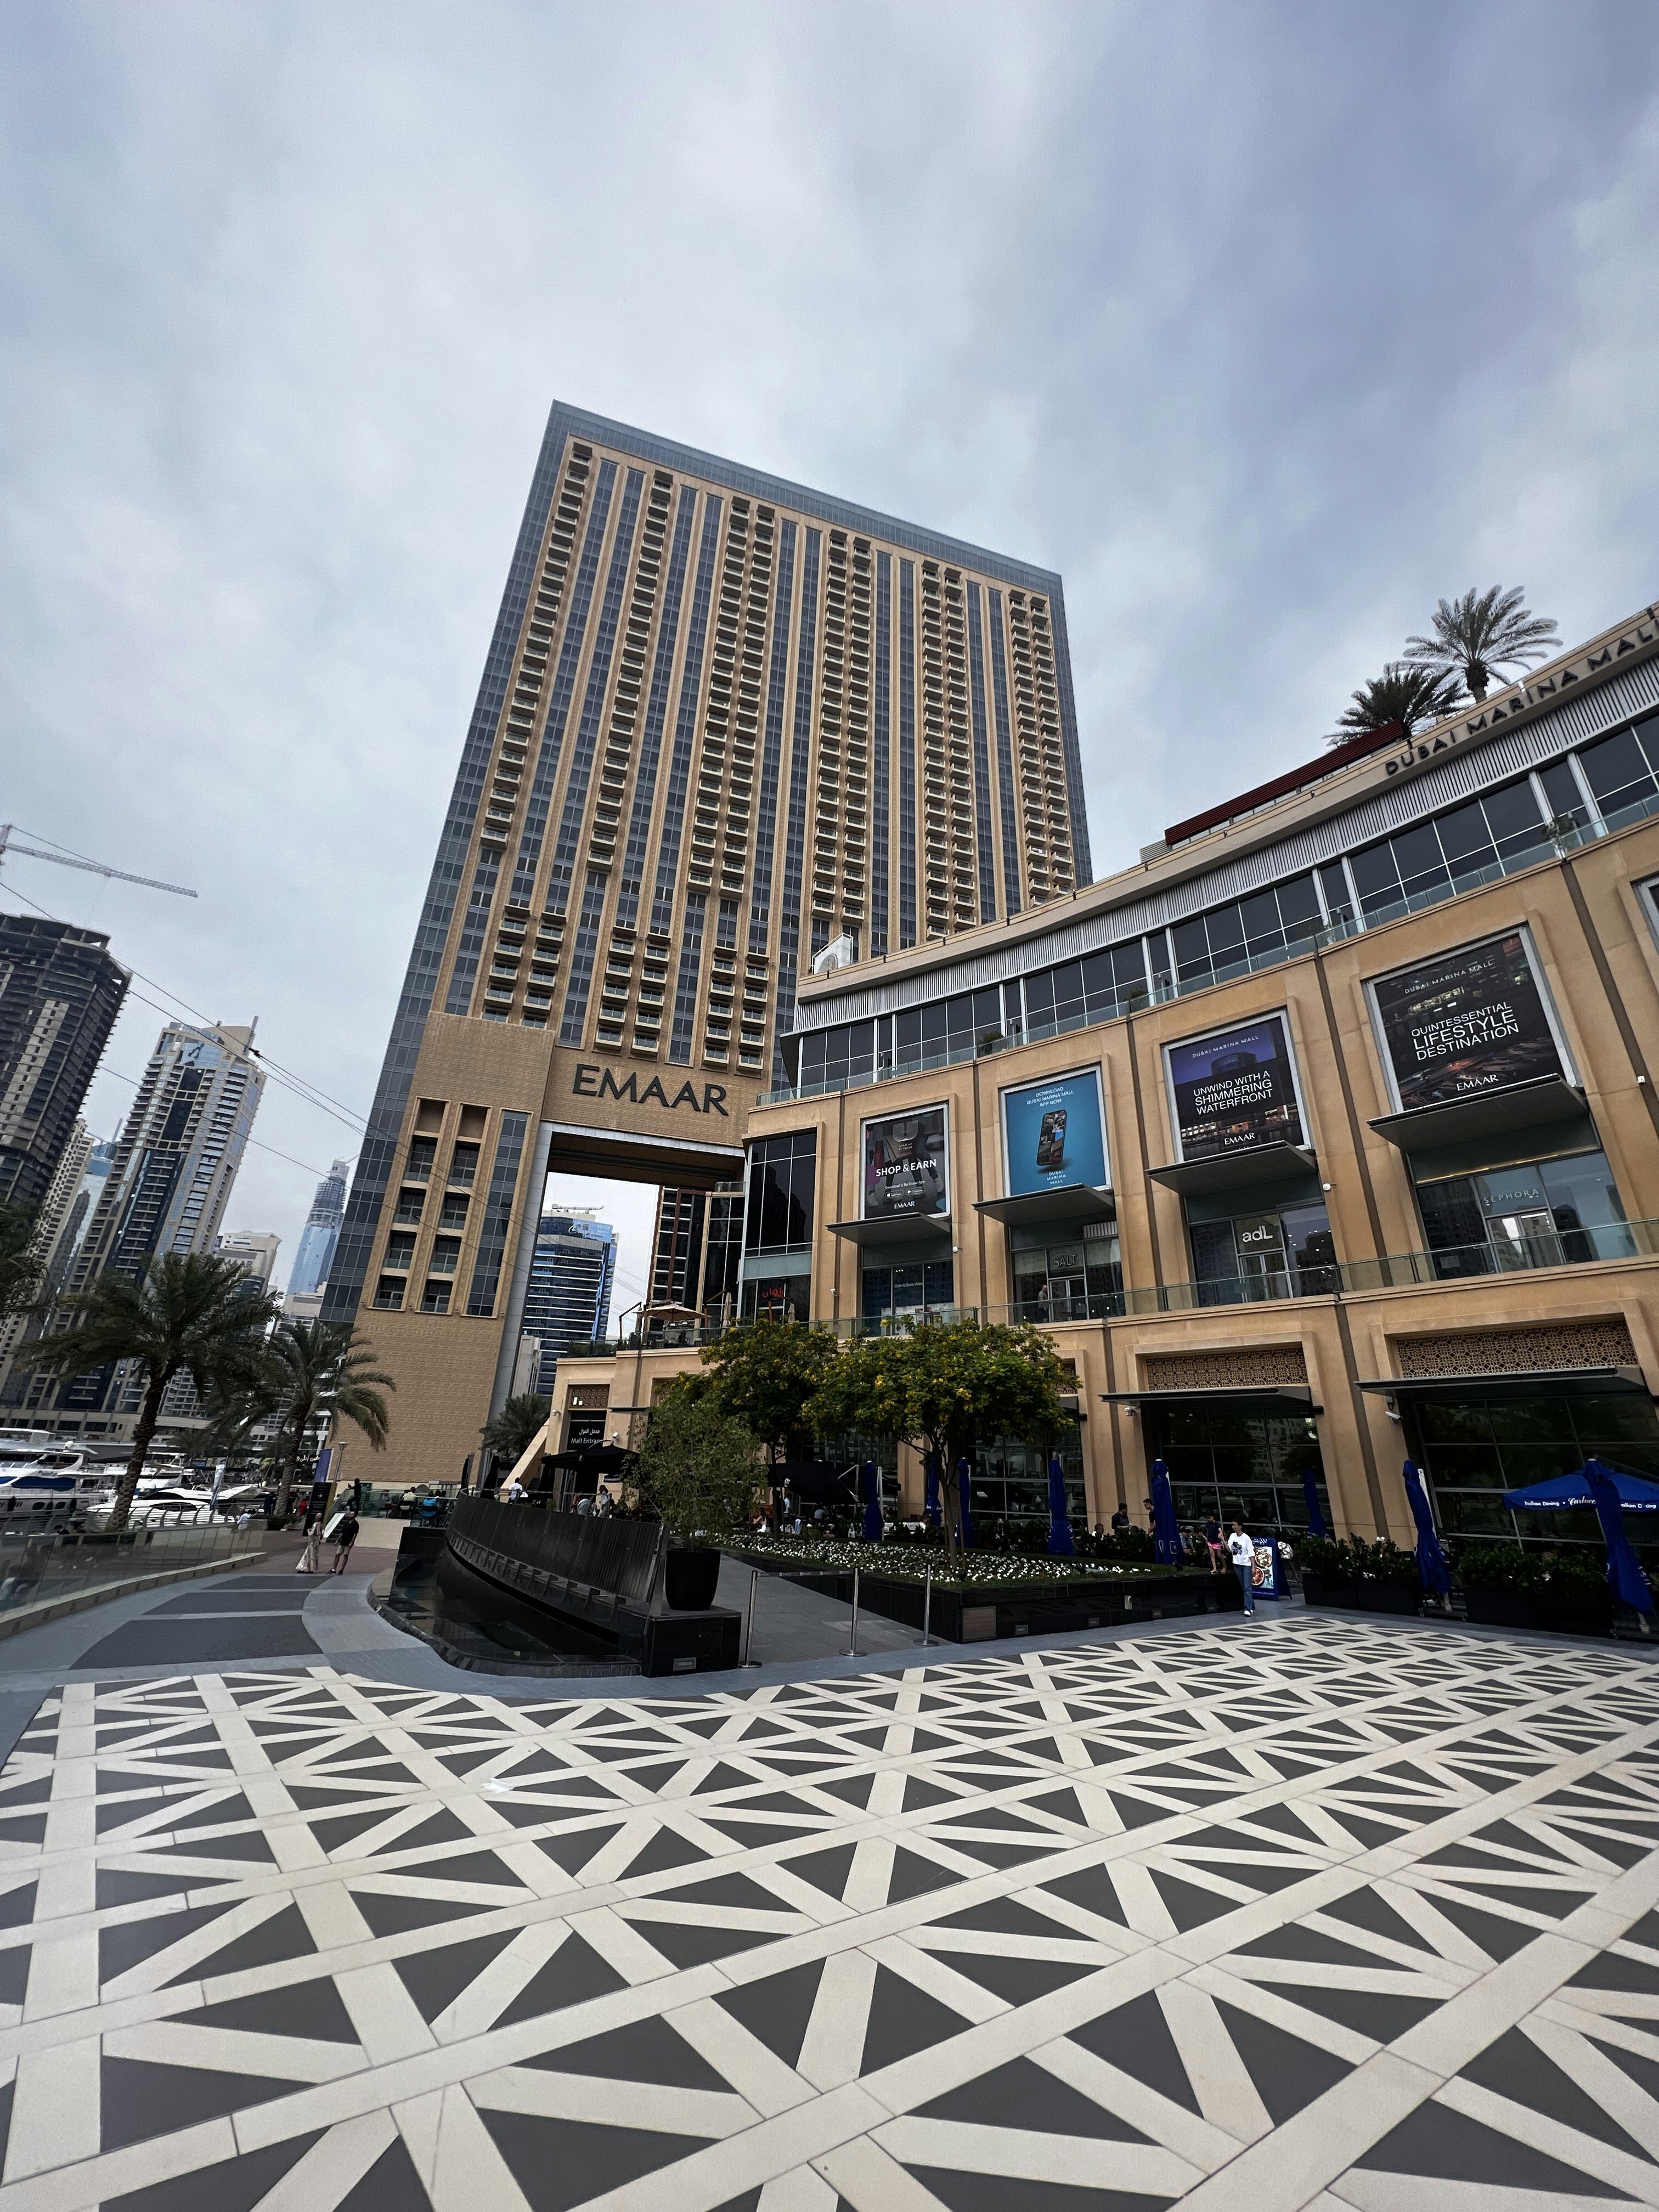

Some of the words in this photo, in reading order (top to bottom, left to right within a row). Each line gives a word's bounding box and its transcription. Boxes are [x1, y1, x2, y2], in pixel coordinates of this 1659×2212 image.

[1385, 730, 1456, 775] DUBAI
[1466, 669, 1578, 735] MARINA
[1404, 983, 1429, 994] DUBAI
[1432, 970, 1466, 985] MARINA
[1469, 961, 1493, 973] MALL
[1411, 1001, 1512, 1037] QUINTESSENTIAL
[1413, 1009, 1516, 1050] LIFESTYLE
[1192, 1048, 1211, 1058] DUBAI
[1213, 1041, 1239, 1052] MARINA
[1241, 1035, 1260, 1044] MALL
[1416, 1022, 1520, 1061] DESTINATION
[572, 1063, 730, 1116] EMAAR
[1036, 1086, 1064, 1097] DOWNLOAD
[1193, 1080, 1233, 1097] UNWIND
[1234, 1072, 1261, 1086] WITH
[1263, 1070, 1270, 1079] A
[1195, 1079, 1272, 1106] SHIMMERING
[1456, 1074, 1499, 1091] EMAAR
[1042, 1093, 1060, 1101] MARINA
[1196, 1088, 1273, 1115] WATERFRONT
[1224, 1132, 1256, 1146] EMAAR
[876, 1165, 901, 1177] SHOP
[902, 1164, 909, 1172] &
[911, 1159, 936, 1171] EARN
[894, 1200, 915, 1209] EMAAR
[1483, 1188, 1539, 1204] SEPHORA
[1053, 1254, 1077, 1267] SALT
